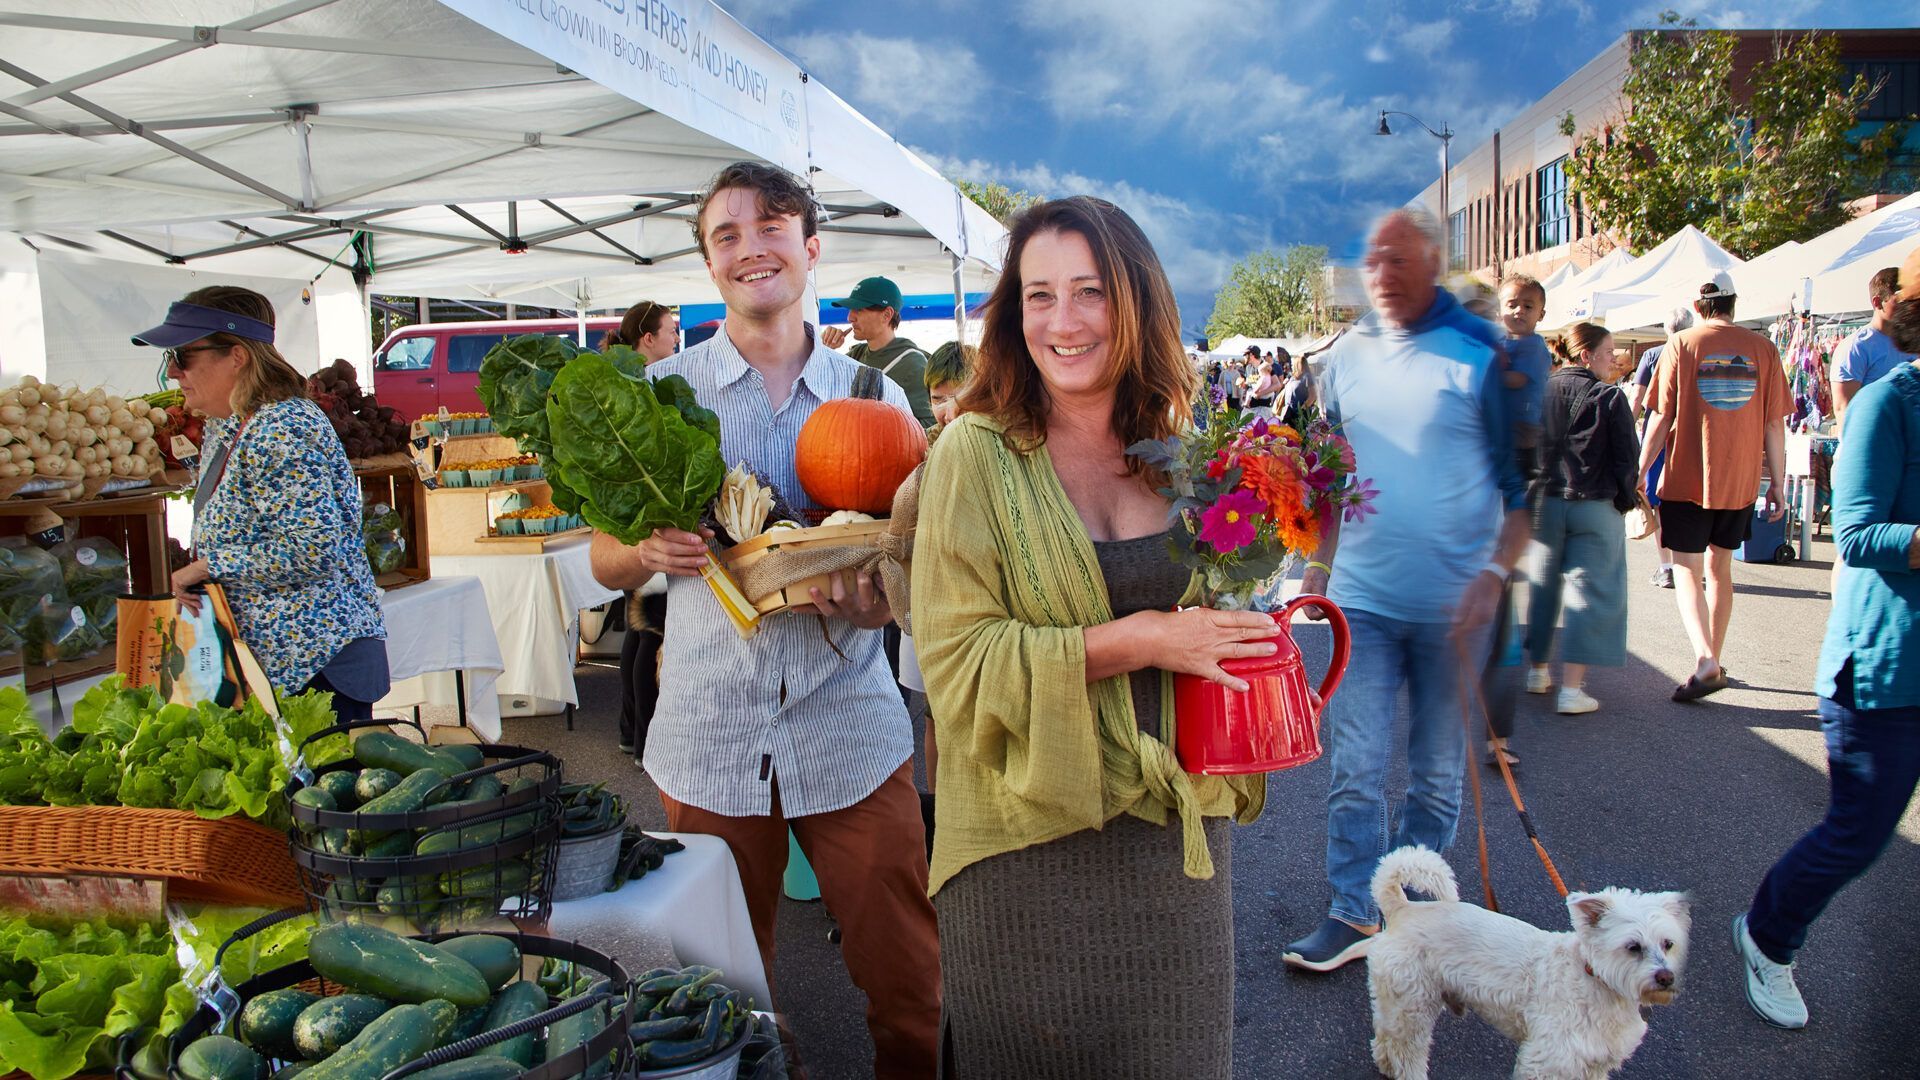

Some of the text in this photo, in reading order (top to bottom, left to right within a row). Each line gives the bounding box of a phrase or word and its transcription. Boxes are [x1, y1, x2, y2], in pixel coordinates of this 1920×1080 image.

[598, 24, 610, 52] IN
[636, 0, 687, 54] HERBS
[691, 30, 721, 77] AND
[725, 52, 767, 106] HONEY
